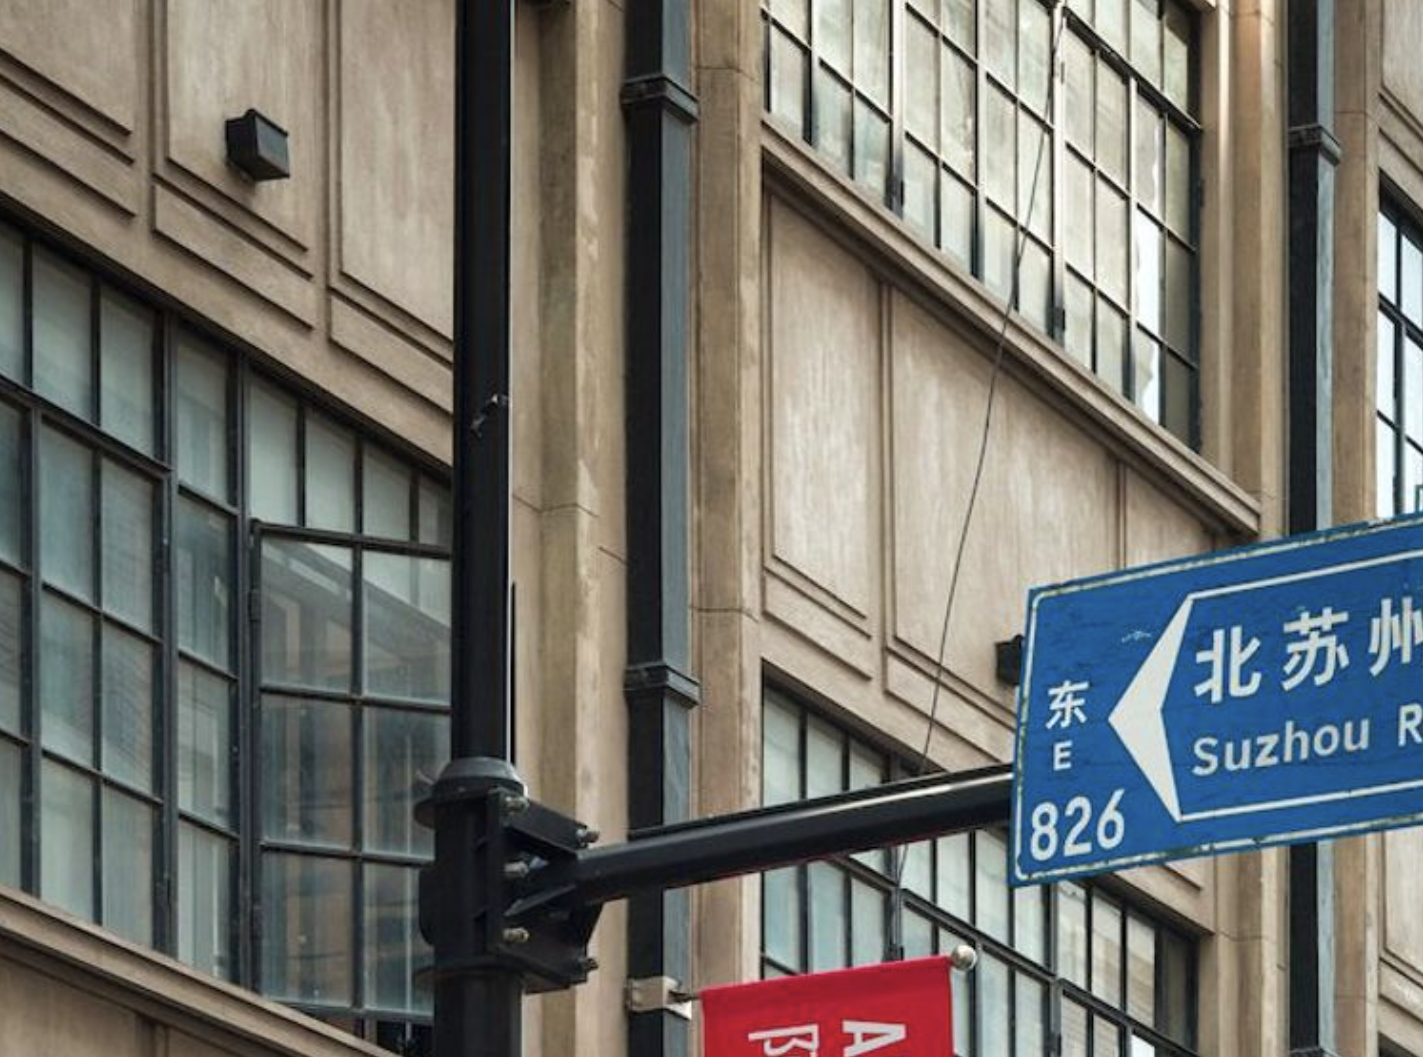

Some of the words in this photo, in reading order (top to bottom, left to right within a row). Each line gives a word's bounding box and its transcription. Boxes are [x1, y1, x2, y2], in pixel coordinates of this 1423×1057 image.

[1044, 680, 1090, 731] 东
[1052, 742, 1073, 772] E
[1191, 717, 1371, 777] Suzhou
[1030, 788, 1127, 863] 826
